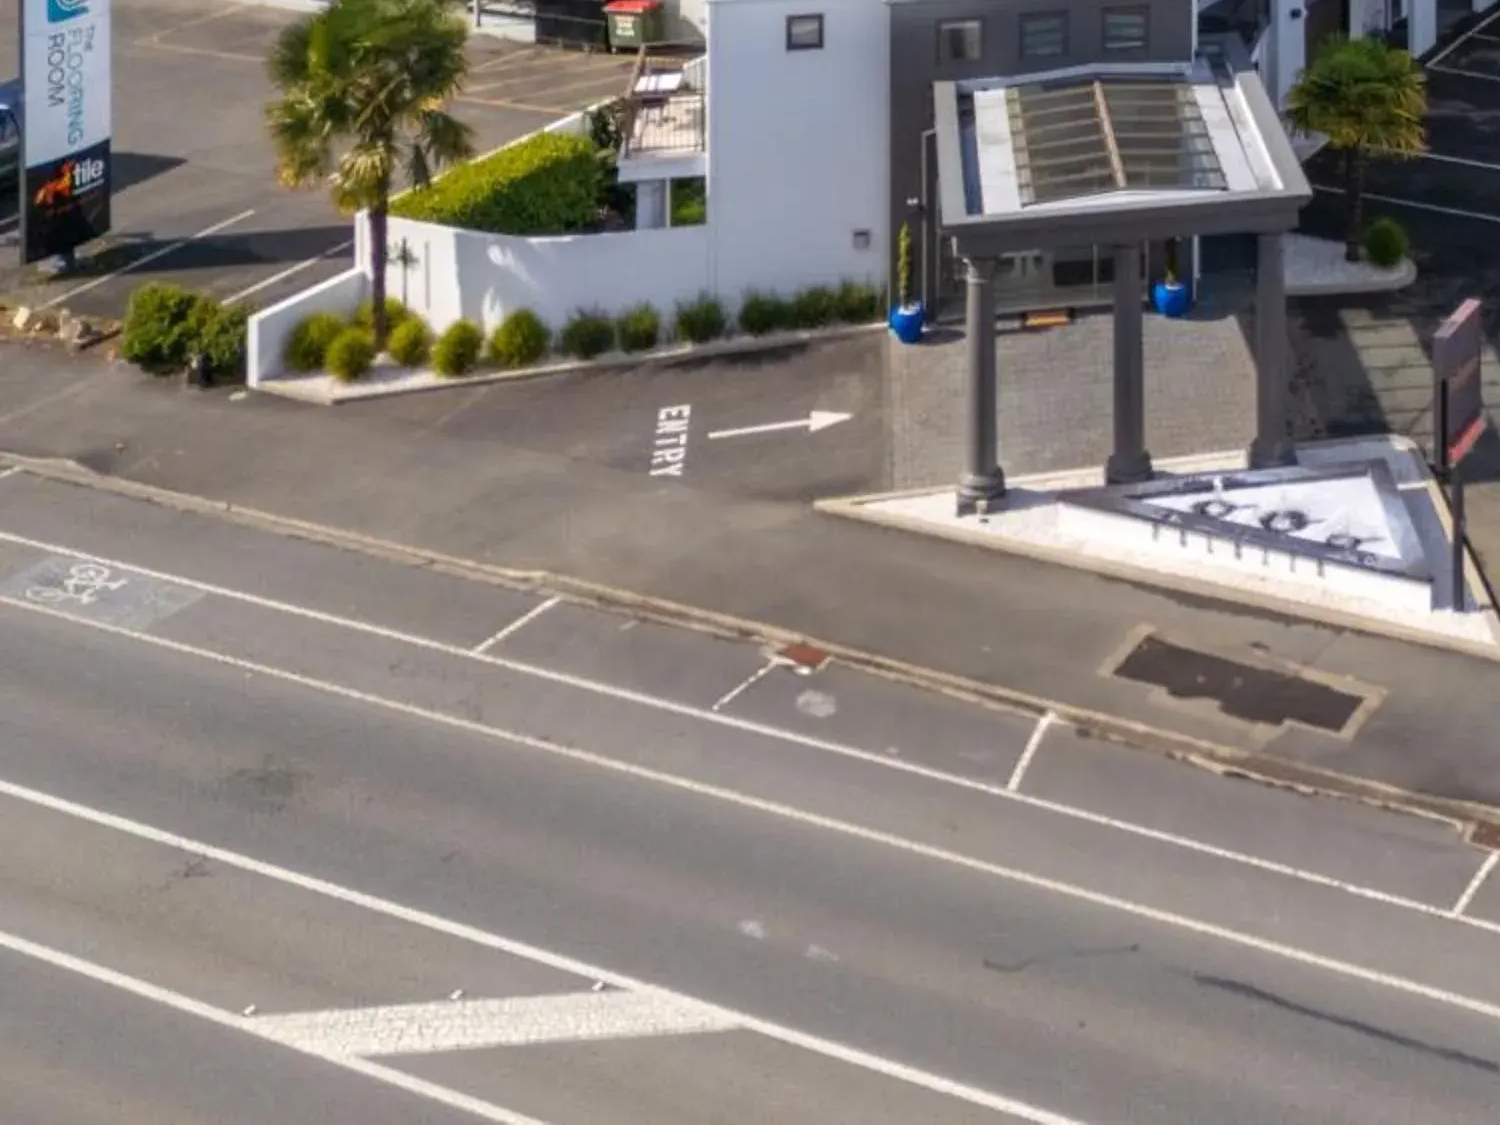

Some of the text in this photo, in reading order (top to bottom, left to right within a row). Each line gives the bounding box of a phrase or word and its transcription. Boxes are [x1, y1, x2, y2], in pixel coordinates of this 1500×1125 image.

[48, 32, 65, 108] ROOM
[67, 27, 84, 144] FLOORING
[73, 157, 105, 187] tile
[649, 404, 692, 476] ENTRY
